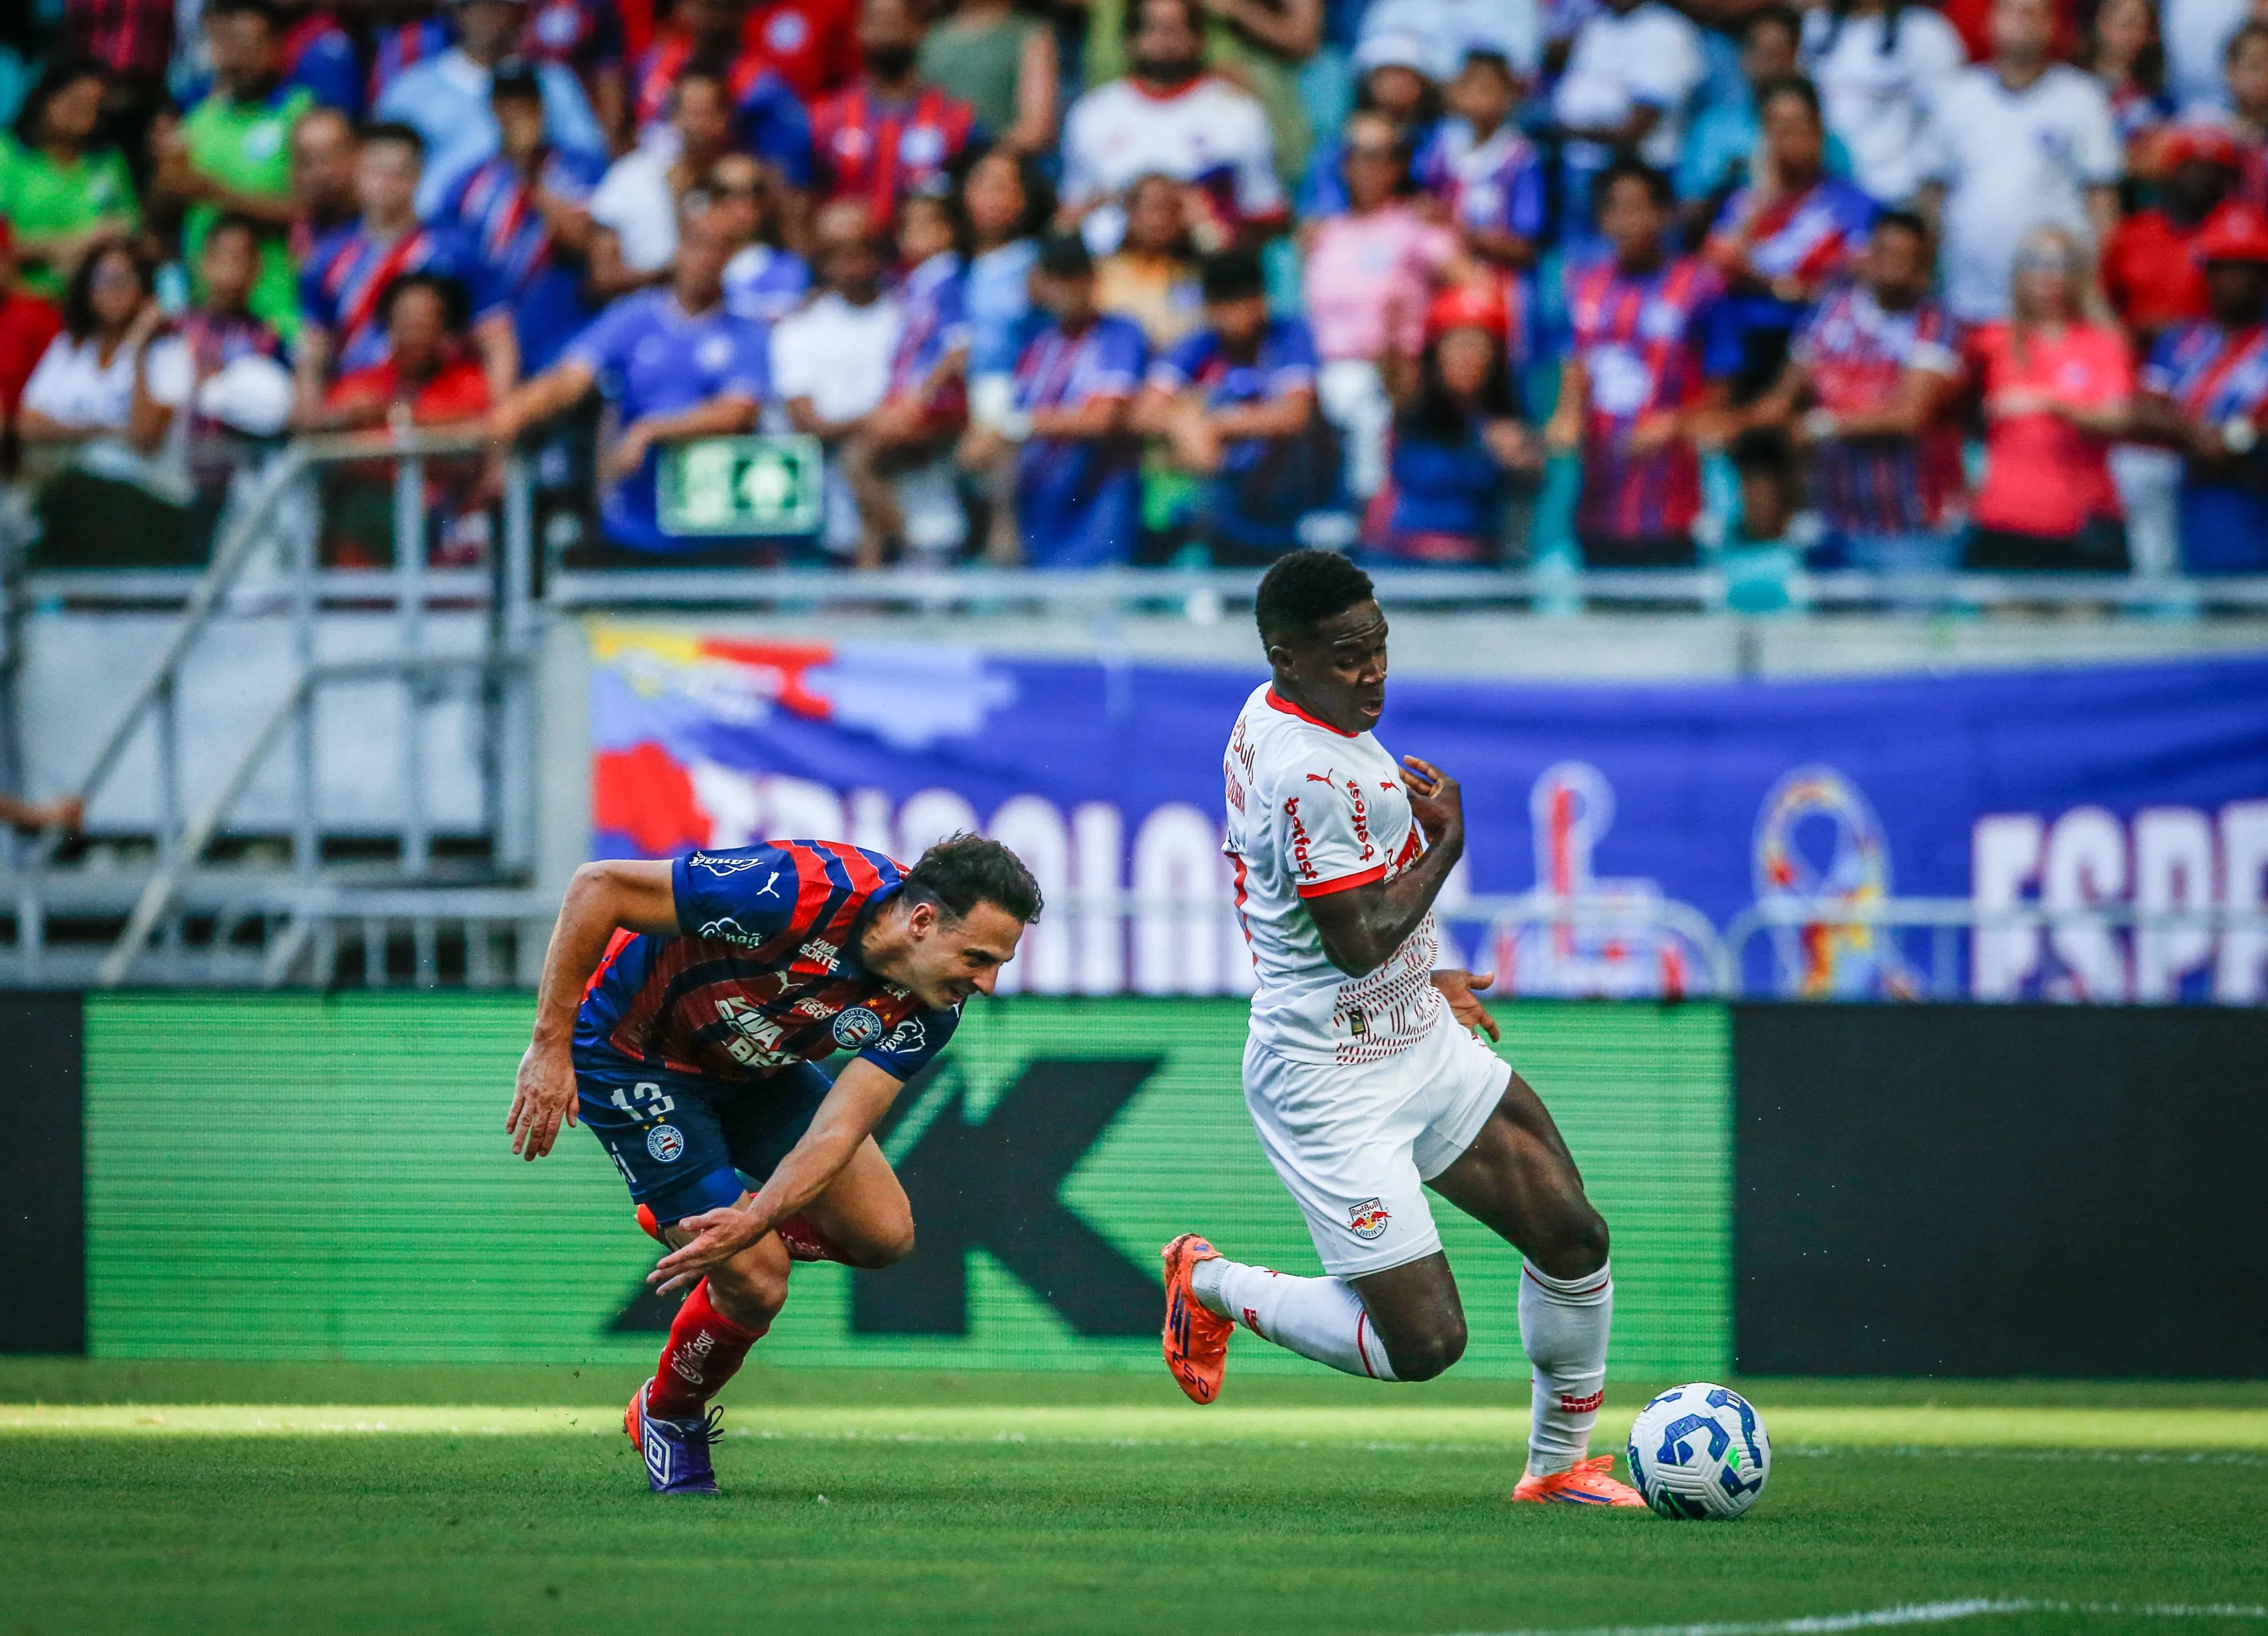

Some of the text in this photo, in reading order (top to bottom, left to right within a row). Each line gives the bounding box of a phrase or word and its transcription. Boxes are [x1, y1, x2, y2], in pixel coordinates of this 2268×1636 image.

[1347, 780, 1374, 862] betfast
[1284, 797, 1318, 880] betfast
[799, 943, 840, 972] SORTE
[812, 938, 838, 957] VIVA
[726, 996, 784, 1050] VIVA
[794, 999, 831, 1021] PISO
[836, 1009, 864, 1028] ESPORTE
[611, 1082, 675, 1121] 13
